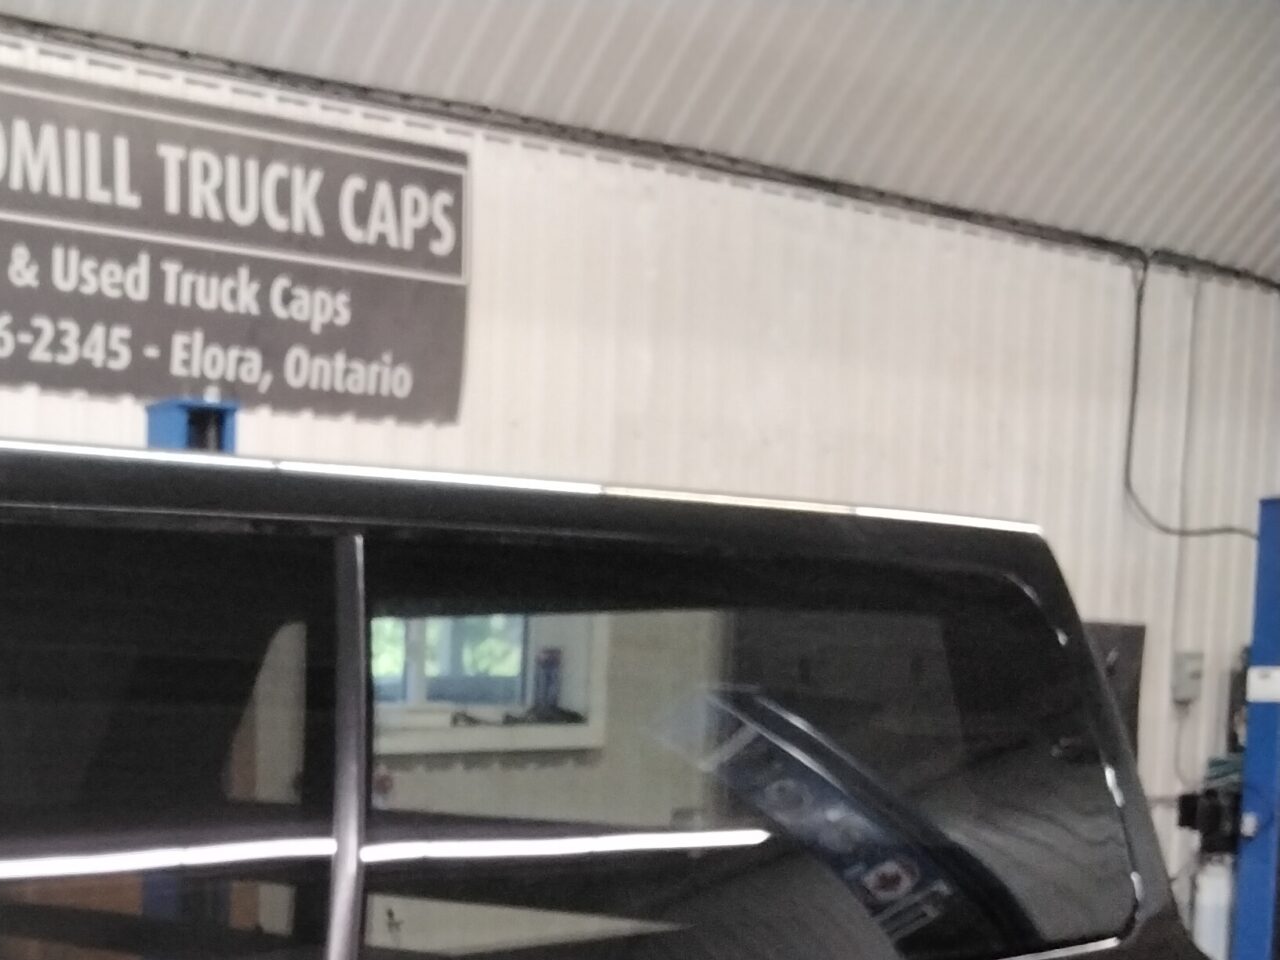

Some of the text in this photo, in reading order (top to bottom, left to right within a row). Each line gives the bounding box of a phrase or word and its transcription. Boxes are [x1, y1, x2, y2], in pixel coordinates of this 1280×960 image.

[156, 143, 325, 238] TRUCK
[338, 172, 457, 257] CAPS
[7, 242, 40, 288] &
[50, 244, 151, 302] Used
[160, 259, 261, 316] Truck
[270, 274, 352, 335] Caps
[170, 328, 274, 394] Elora,
[283, 344, 413, 399] Ontario
